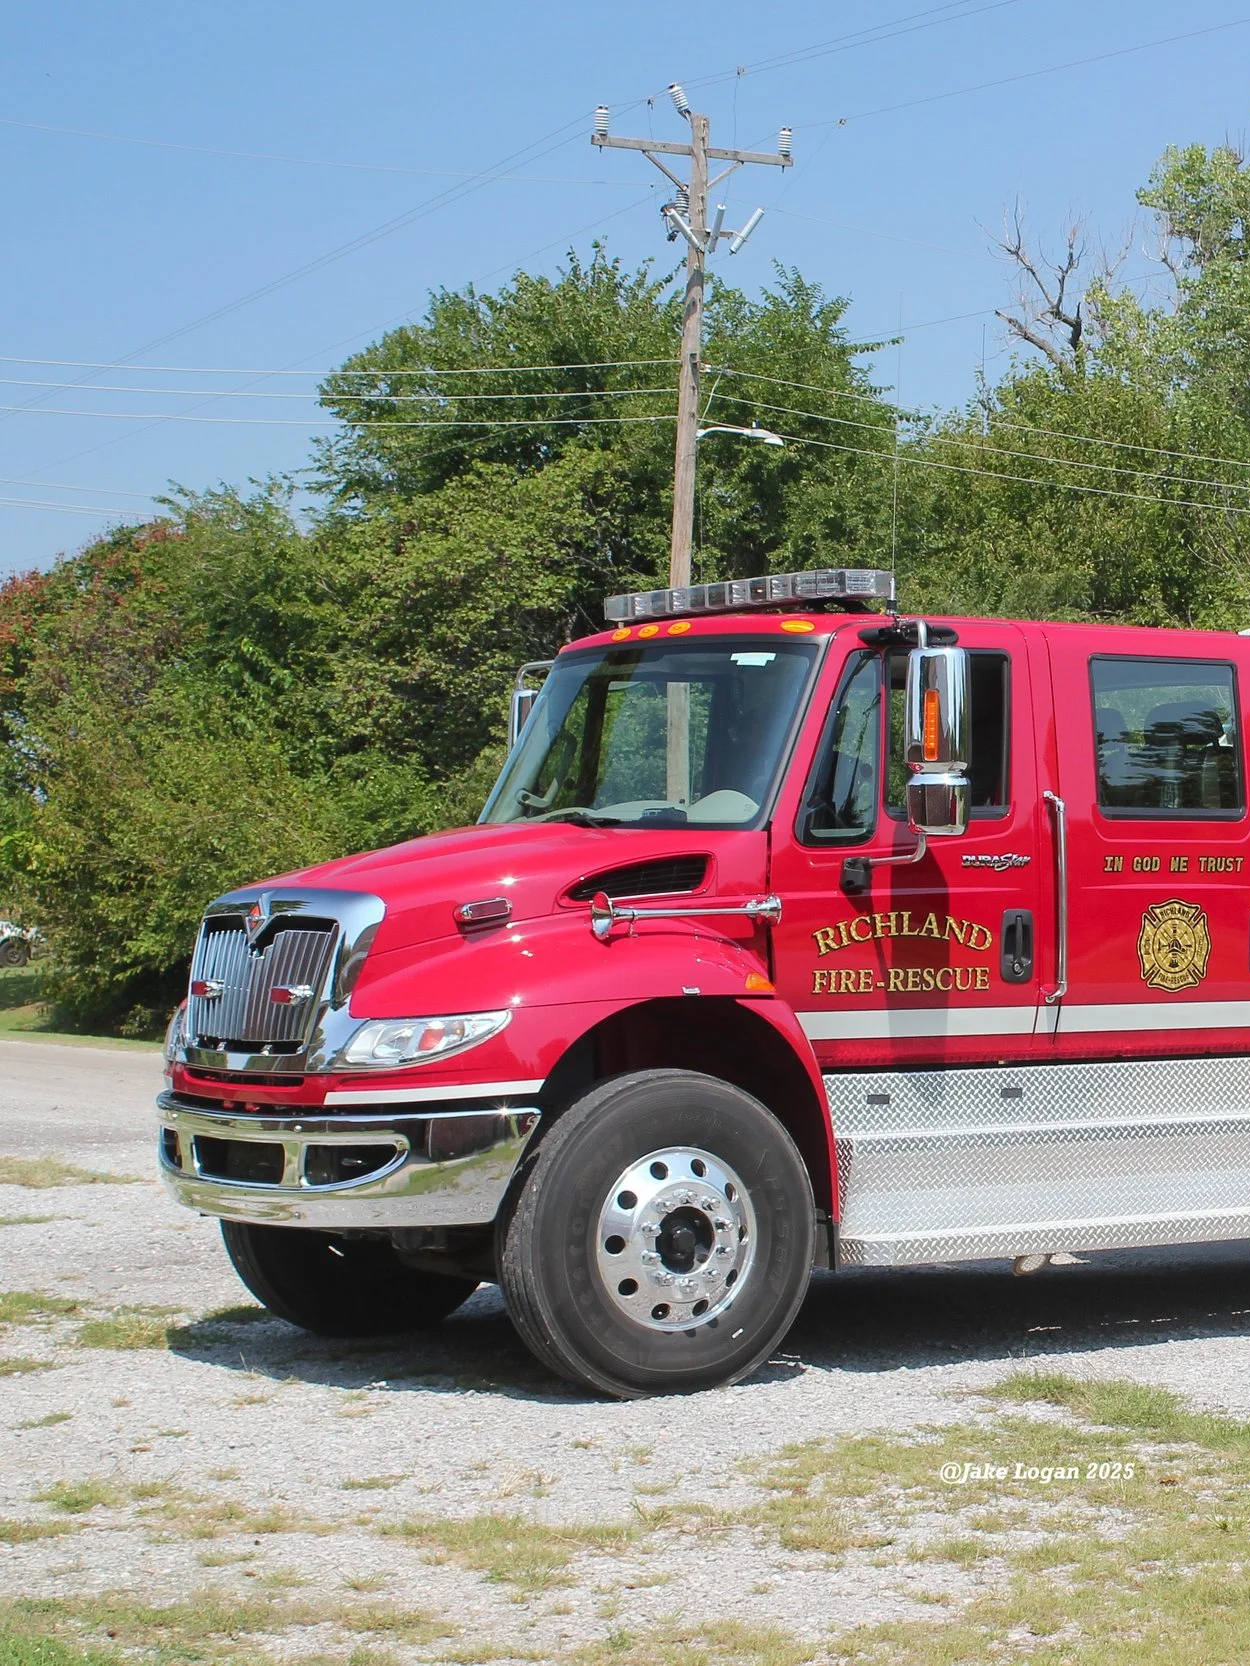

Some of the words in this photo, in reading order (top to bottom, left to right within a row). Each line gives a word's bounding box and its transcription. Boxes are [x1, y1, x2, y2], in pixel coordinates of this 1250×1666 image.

[1103, 856, 1124, 872] IN
[1133, 856, 1161, 872] GOD
[1169, 856, 1189, 872] WE
[1199, 856, 1245, 872] TRUST
[1160, 905, 1190, 919] RICHLAND
[812, 911, 994, 956] RICHLAND
[812, 967, 990, 994] FIRE-RESCUE
